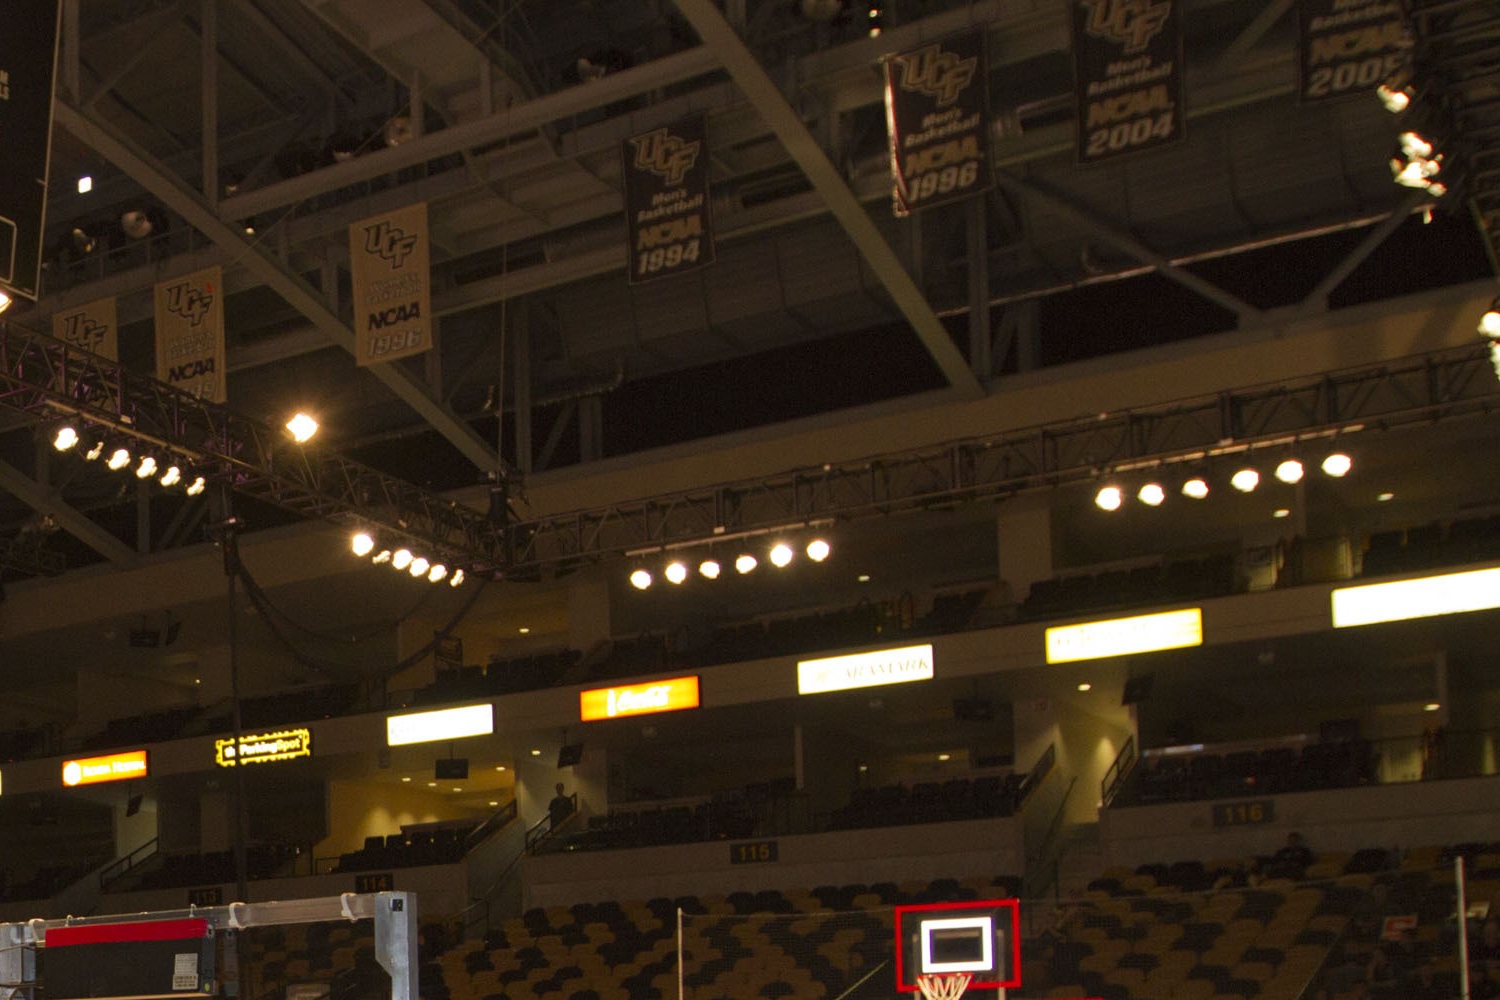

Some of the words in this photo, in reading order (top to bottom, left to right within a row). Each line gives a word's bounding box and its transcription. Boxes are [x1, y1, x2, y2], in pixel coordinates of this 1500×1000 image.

[893, 44, 977, 107] UCF
[1087, 84, 1170, 128] NCAA
[905, 134, 979, 176] NCAA
[1087, 112, 1175, 156] 2004
[629, 128, 700, 187] UCF
[909, 162, 978, 204] 1996
[364, 220, 417, 269] UCF
[638, 214, 701, 251] NCAA
[639, 239, 700, 275] 1994
[164, 283, 213, 327] UCF
[368, 302, 420, 331] NCAA
[168, 358, 216, 383] NCAA
